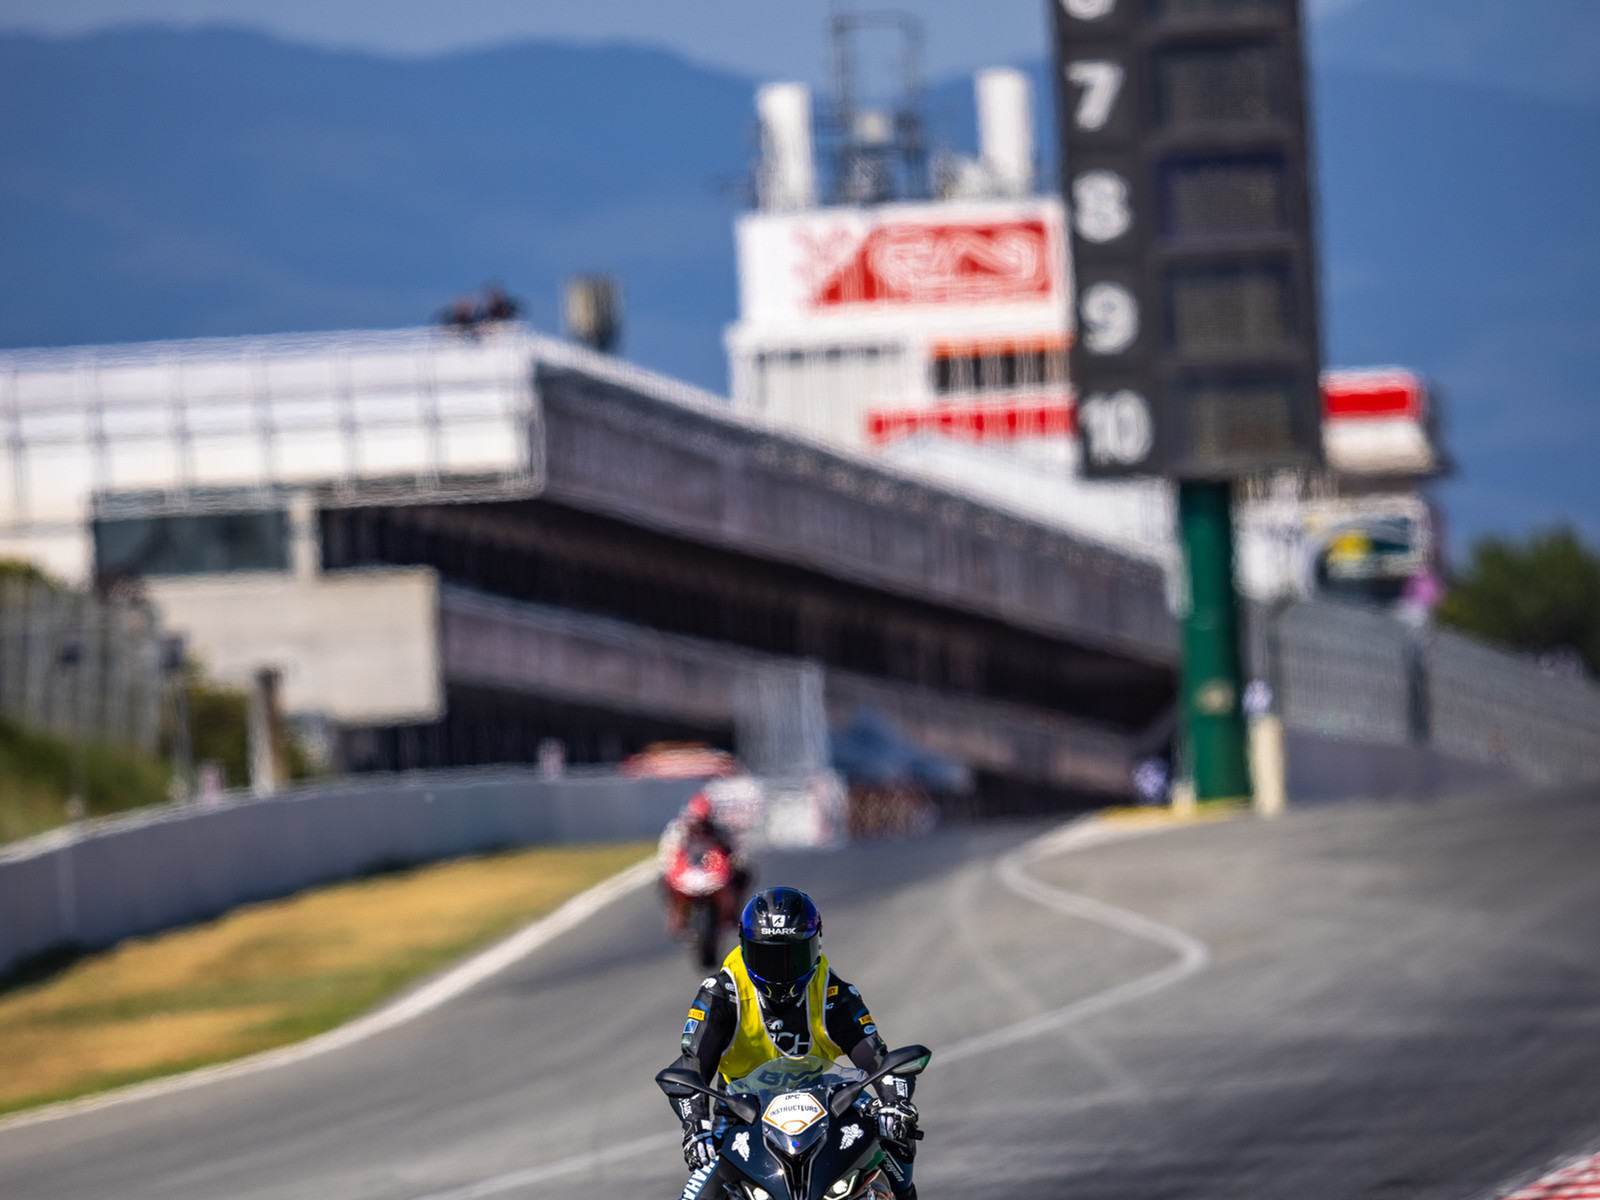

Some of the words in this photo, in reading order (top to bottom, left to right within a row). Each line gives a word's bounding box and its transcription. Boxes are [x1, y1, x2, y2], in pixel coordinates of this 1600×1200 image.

[1066, 59, 1124, 130] 7
[1072, 169, 1132, 243] 8
[1079, 281, 1139, 355] 9
[1080, 389, 1154, 466] 10
[761, 927, 796, 935] SHARK
[769, 1104, 819, 1117] INSTRUCTEURS
